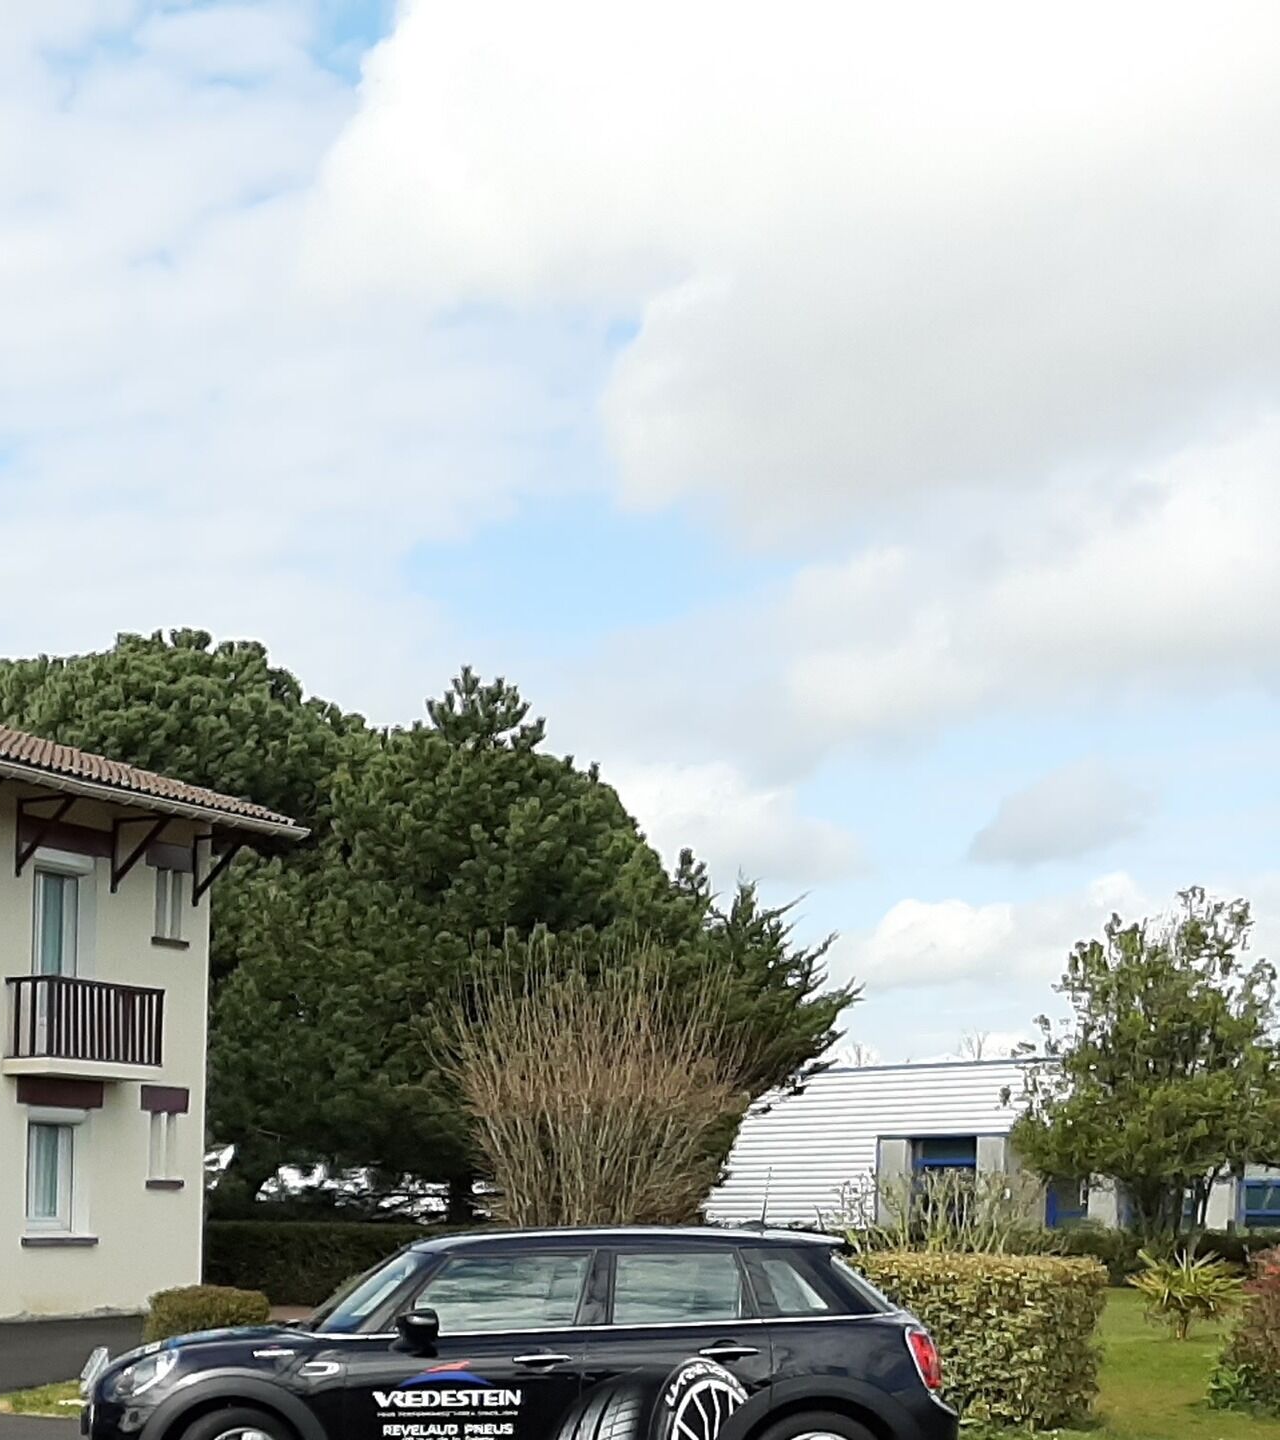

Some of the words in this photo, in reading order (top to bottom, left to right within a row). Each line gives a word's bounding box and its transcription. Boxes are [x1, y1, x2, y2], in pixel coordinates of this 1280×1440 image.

[372, 1389, 522, 1408] VREDESTEIN
[383, 1423, 458, 1436] REVELAUD
[464, 1423, 514, 1435] PNEUS
